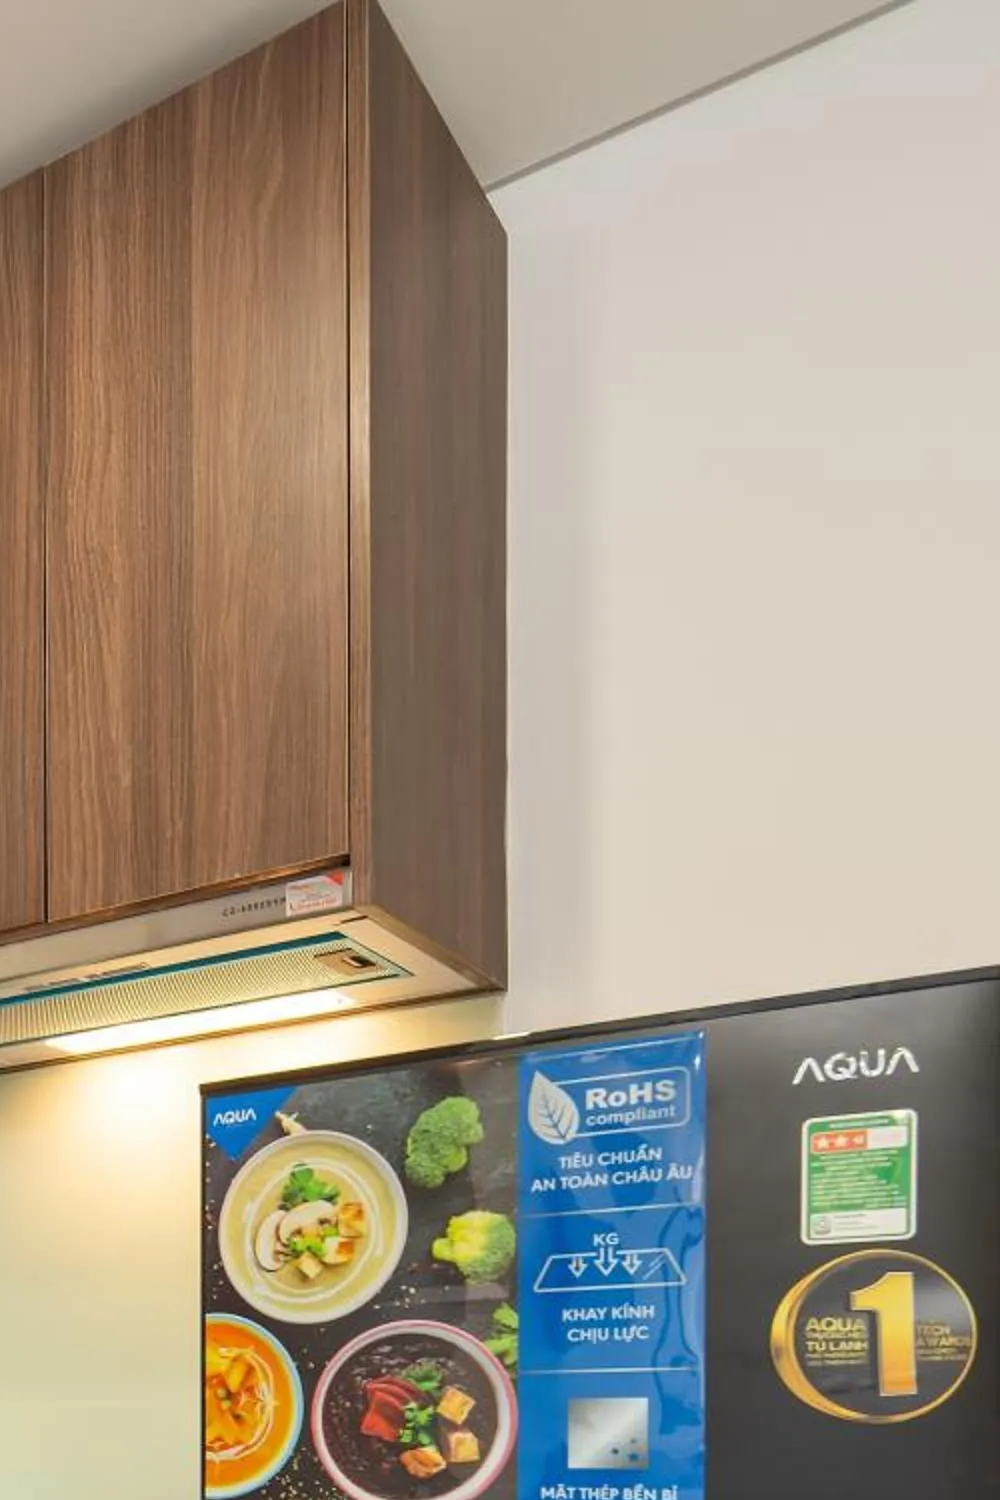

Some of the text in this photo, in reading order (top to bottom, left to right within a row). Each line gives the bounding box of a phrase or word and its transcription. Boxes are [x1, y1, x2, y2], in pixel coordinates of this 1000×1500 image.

[792, 1047, 920, 1085] AQUA
[585, 1079, 676, 1111] RoHS
[213, 1107, 257, 1127] AQUA
[585, 1105, 676, 1126] compliant
[560, 1152, 593, 1169] TIÊU
[531, 1163, 693, 1192] AN TOÀN CHÂU ÂU
[593, 1233, 620, 1247] KG
[562, 1302, 655, 1322] KHAY KÍNH
[805, 1316, 867, 1332] AQUA
[849, 1271, 918, 1397] 1
[567, 1325, 650, 1344] CHỊU LỰC
[578, 1483, 620, 1500] THÉP
